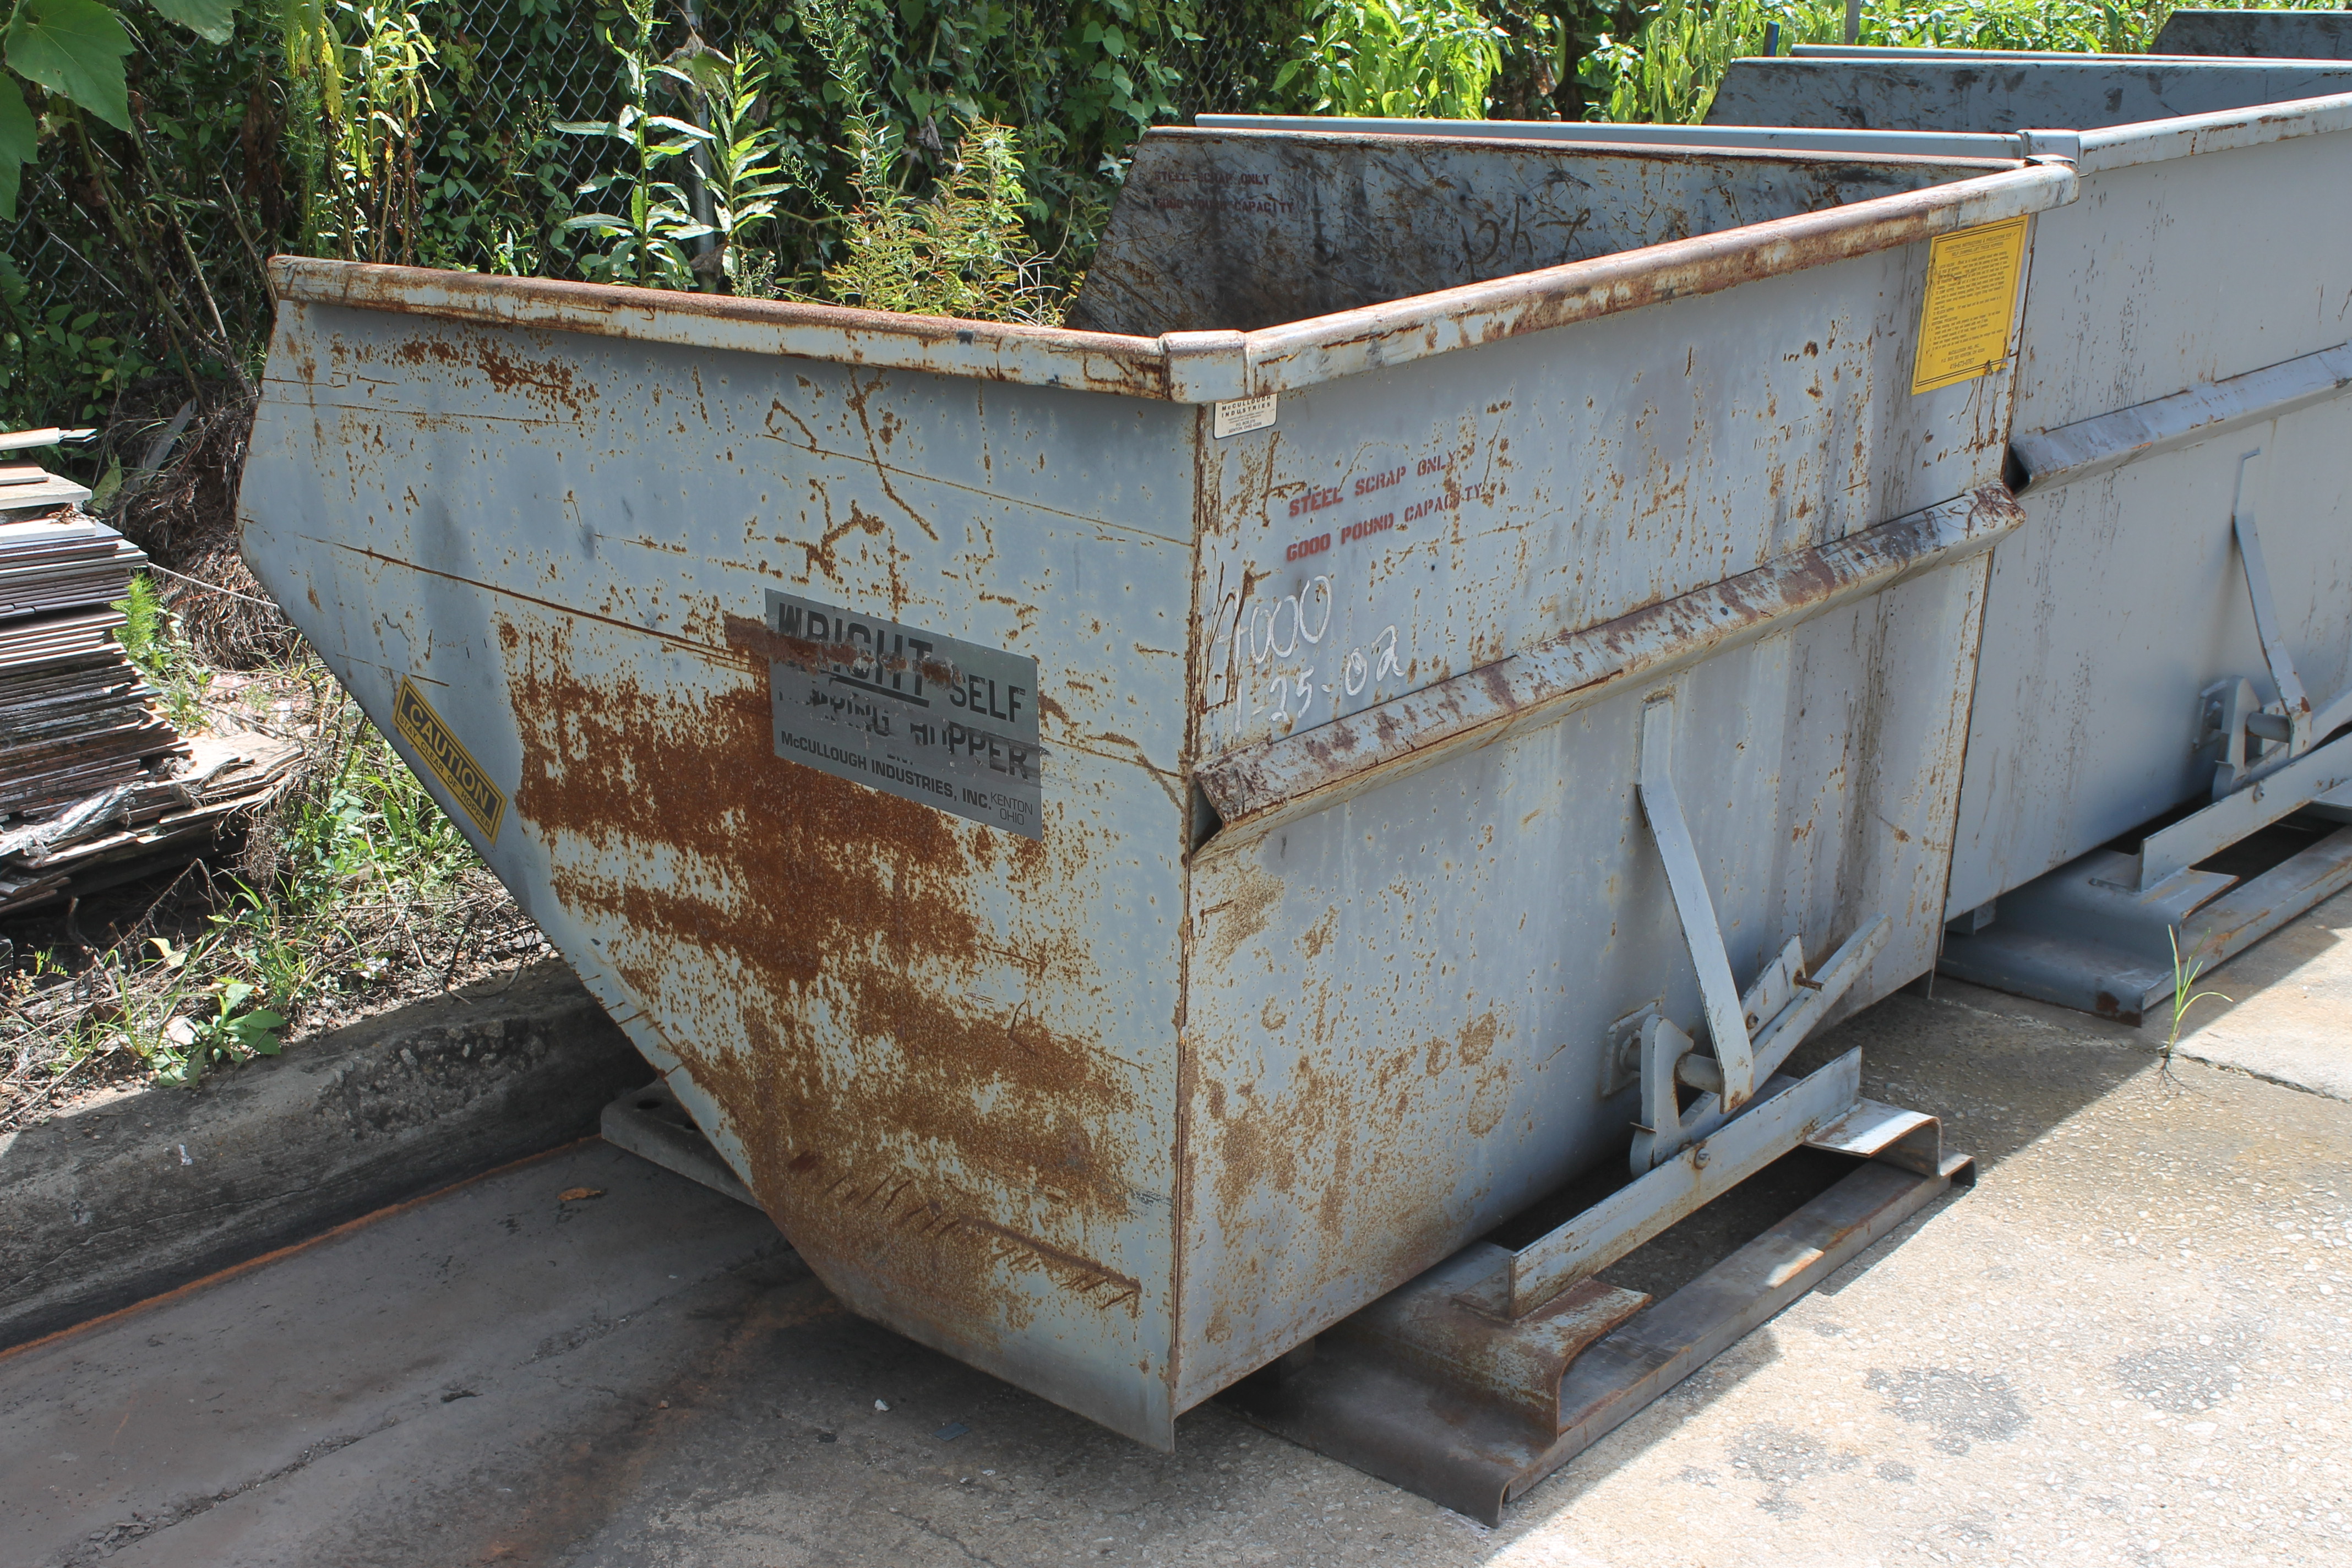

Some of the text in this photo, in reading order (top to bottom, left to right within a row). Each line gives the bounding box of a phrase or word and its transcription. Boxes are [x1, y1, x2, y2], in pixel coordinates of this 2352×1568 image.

[1155, 171, 1190, 182] STEEL
[1240, 173, 1272, 186] ONLY
[1234, 202, 1294, 214] CAPACITY
[1221, 402, 1271, 418] INDUSTRIES
[1222, 395, 1271, 411] McCULLOUGH
[1289, 450, 1457, 518] STEEL SCRAP ONLY
[1341, 512, 1395, 545] POUND
[949, 672, 1026, 723] SELF
[399, 715, 491, 830] STAY CLEAR OF HOPPER
[409, 704, 489, 809] CAUTION
[781, 730, 867, 771] McCULLOUGH
[871, 759, 957, 802] INDUSTRIES,
[962, 787, 992, 810] INC.
[990, 791, 1033, 815] KENTON
[1000, 809, 1025, 826] OHIO
